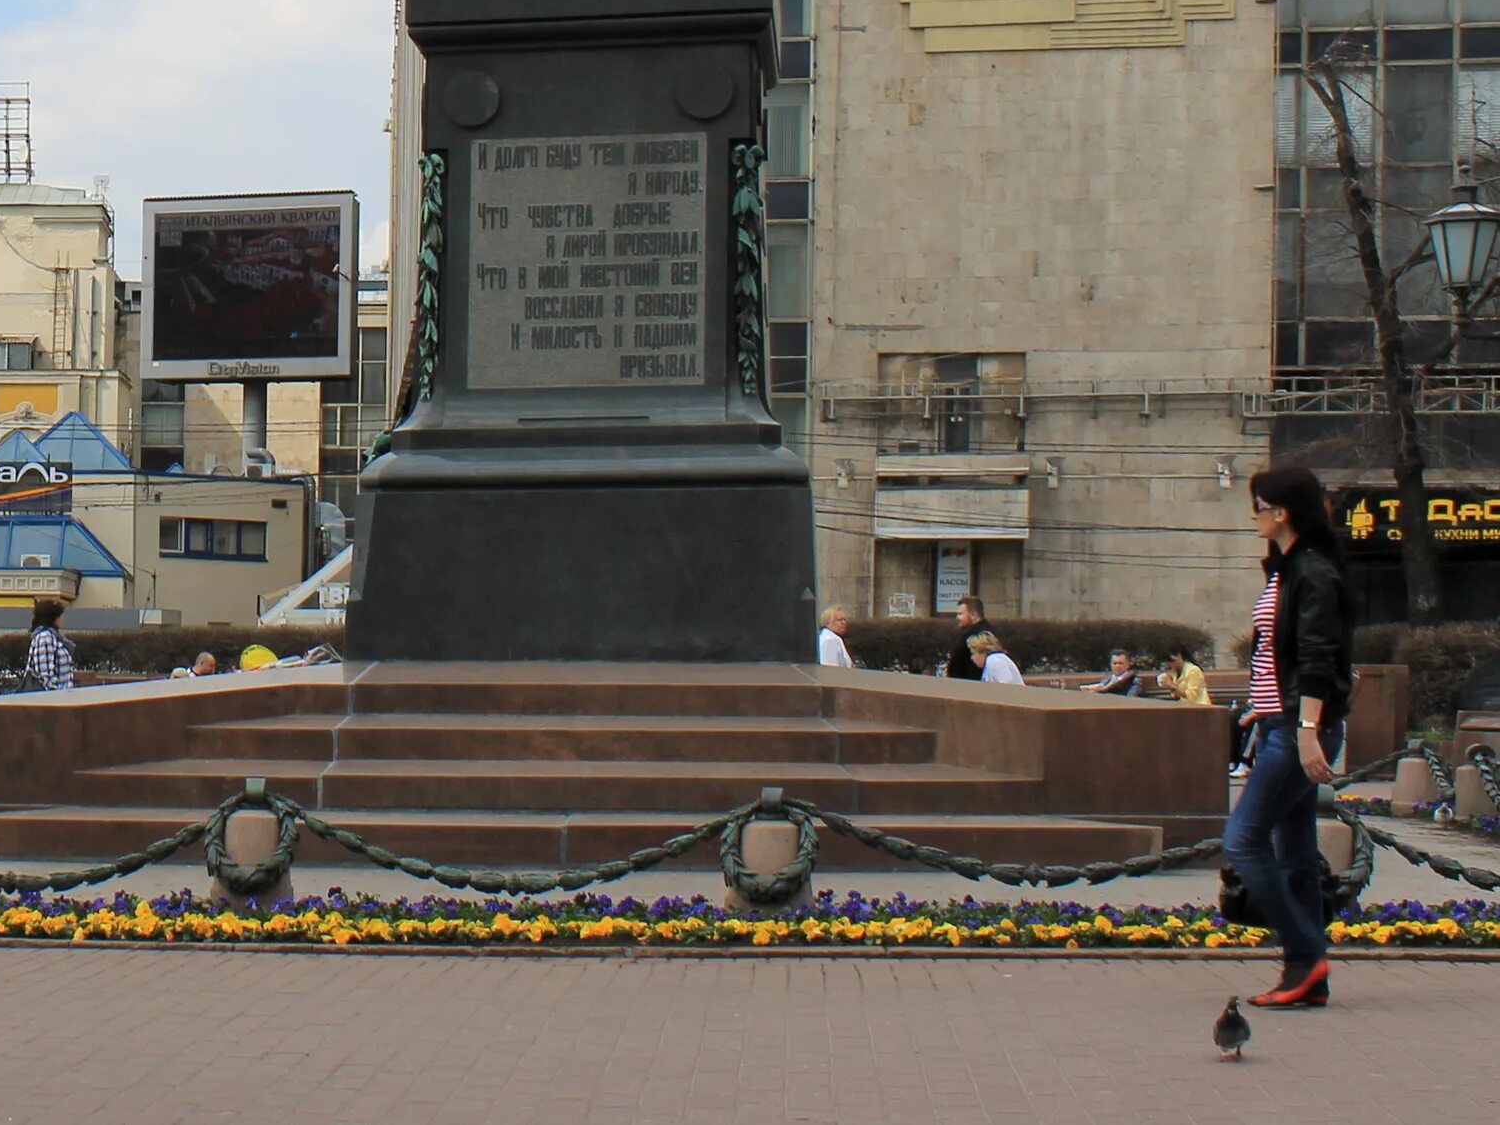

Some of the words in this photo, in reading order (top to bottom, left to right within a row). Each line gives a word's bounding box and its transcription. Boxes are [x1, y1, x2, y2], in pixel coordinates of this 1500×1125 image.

[477, 143, 487, 170] И
[494, 144, 539, 172] ДОЛГО
[546, 142, 582, 170] БУДУ
[589, 141, 625, 167] ТЕМ
[632, 139, 699, 165] ЛЮБЕЗЕН
[627, 171, 637, 195] Я
[186, 212, 276, 227] ИТАЛЬЯНСКИЙ
[281, 210, 336, 223] КВАРТАЛ
[527, 203, 594, 228] ЧУВСТВА
[613, 201, 671, 229] ДОБРЫЕ
[546, 234, 555, 258] Я
[562, 230, 606, 257] ЛИРОЙ
[518, 266, 527, 290] В
[537, 261, 569, 289] МОЙ
[579, 259, 660, 288] ЖЕСТОКИЙ
[671, 262, 698, 285] ВЕК
[524, 294, 604, 320] ВОССЛАВИЛ
[614, 294, 624, 317] Я
[634, 292, 698, 319] СВОБОДУ
[510, 323, 520, 350] И
[531, 324, 602, 350] МИЛОСТЬ
[634, 322, 697, 350] ПАДШИМ
[940, 578, 969, 586] КАССЫ
